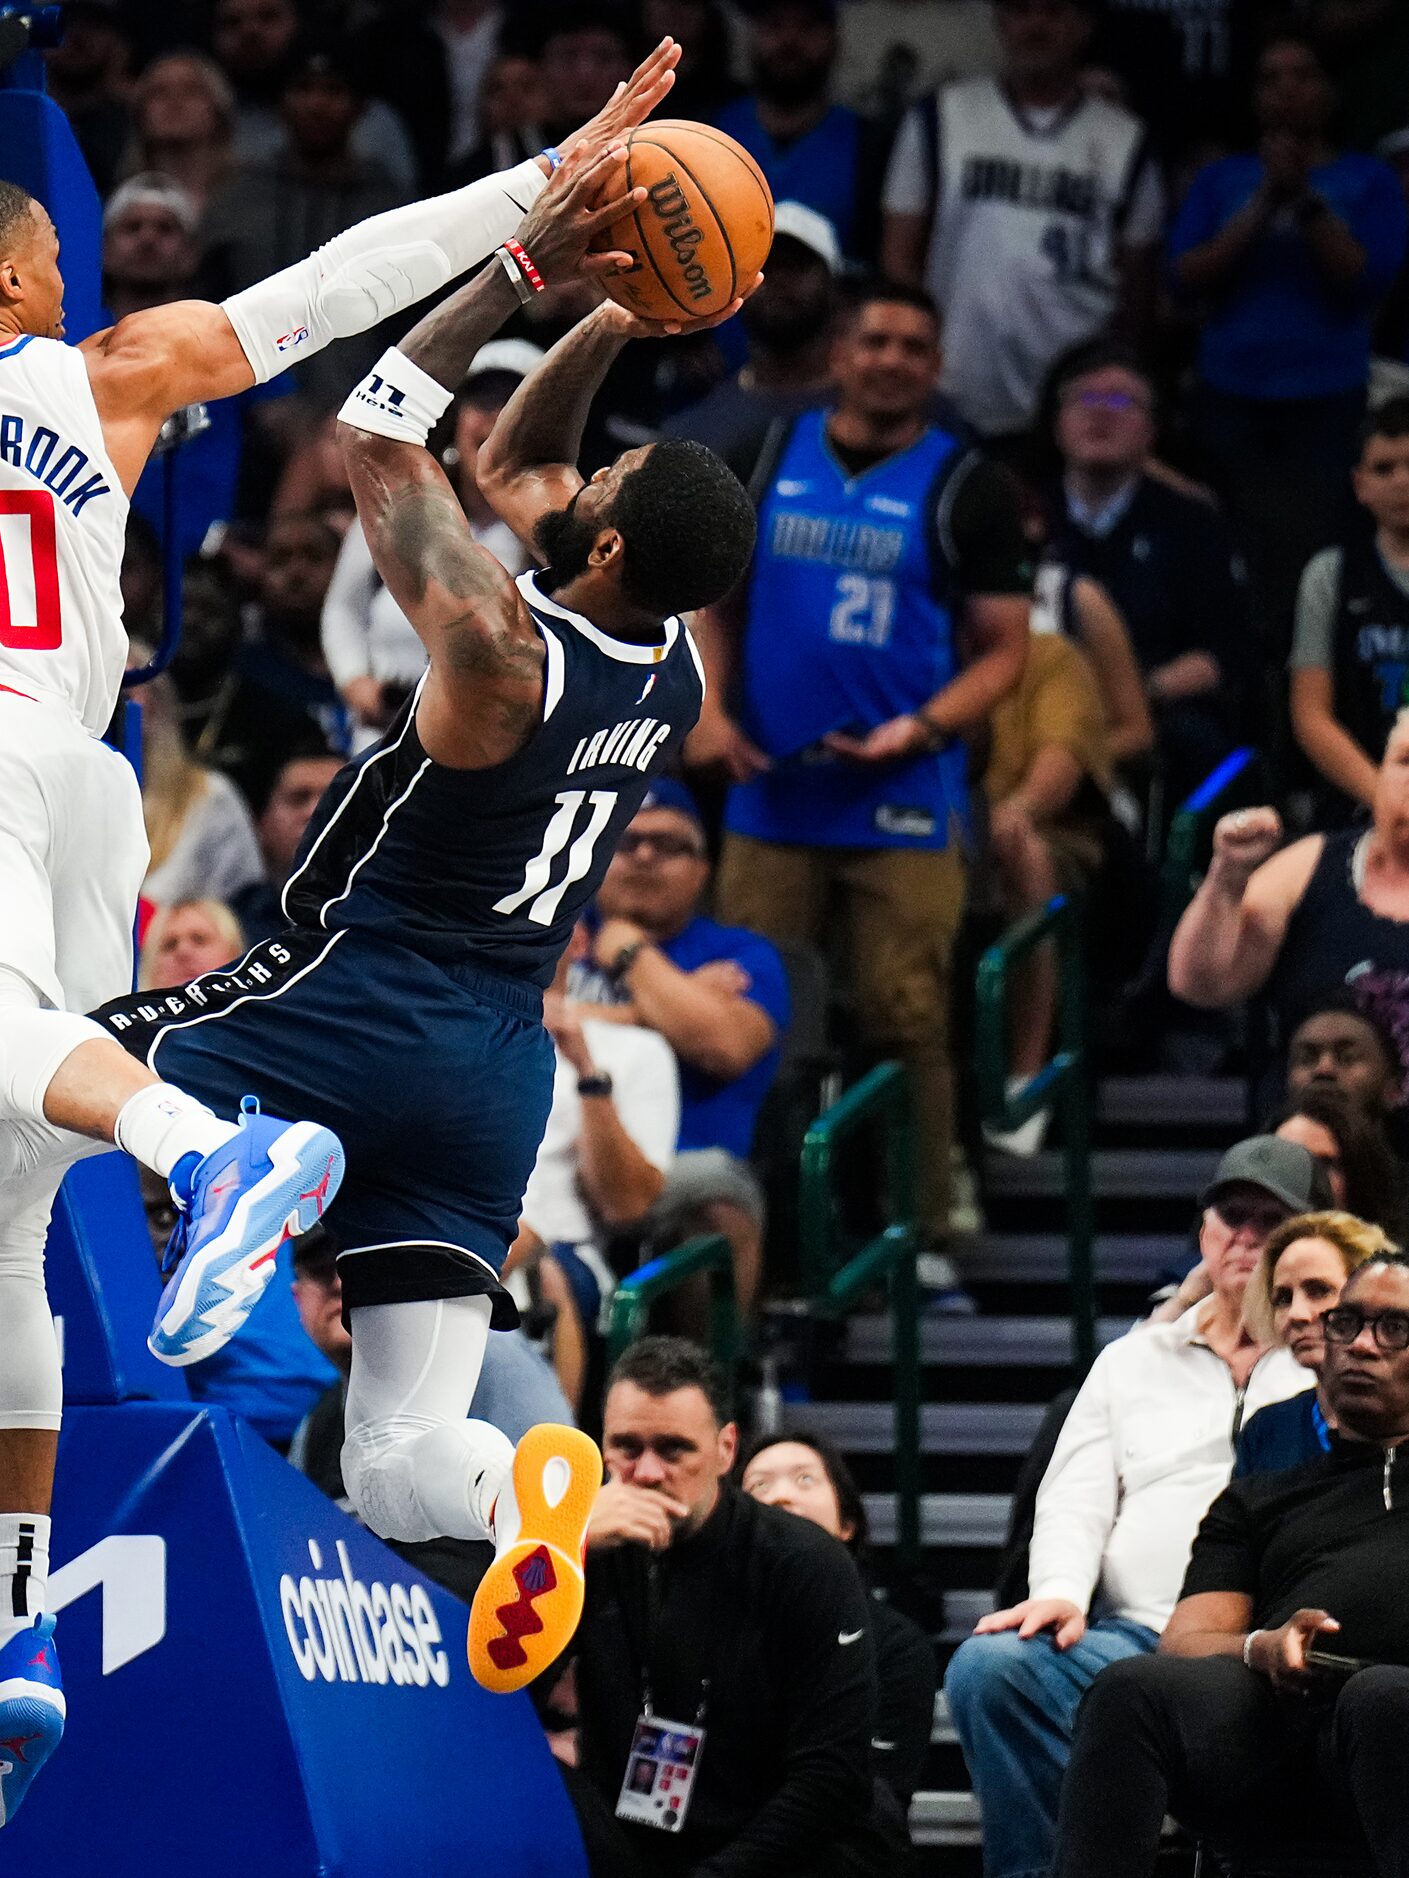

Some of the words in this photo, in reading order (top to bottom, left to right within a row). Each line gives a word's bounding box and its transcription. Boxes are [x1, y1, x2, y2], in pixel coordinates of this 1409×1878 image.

[647, 171, 713, 300] Wilson
[368, 374, 406, 407] 11
[829, 574, 896, 648] 21
[566, 717, 672, 776] IRVING
[492, 790, 619, 927] 11
[279, 1538, 451, 1688] coinbase
